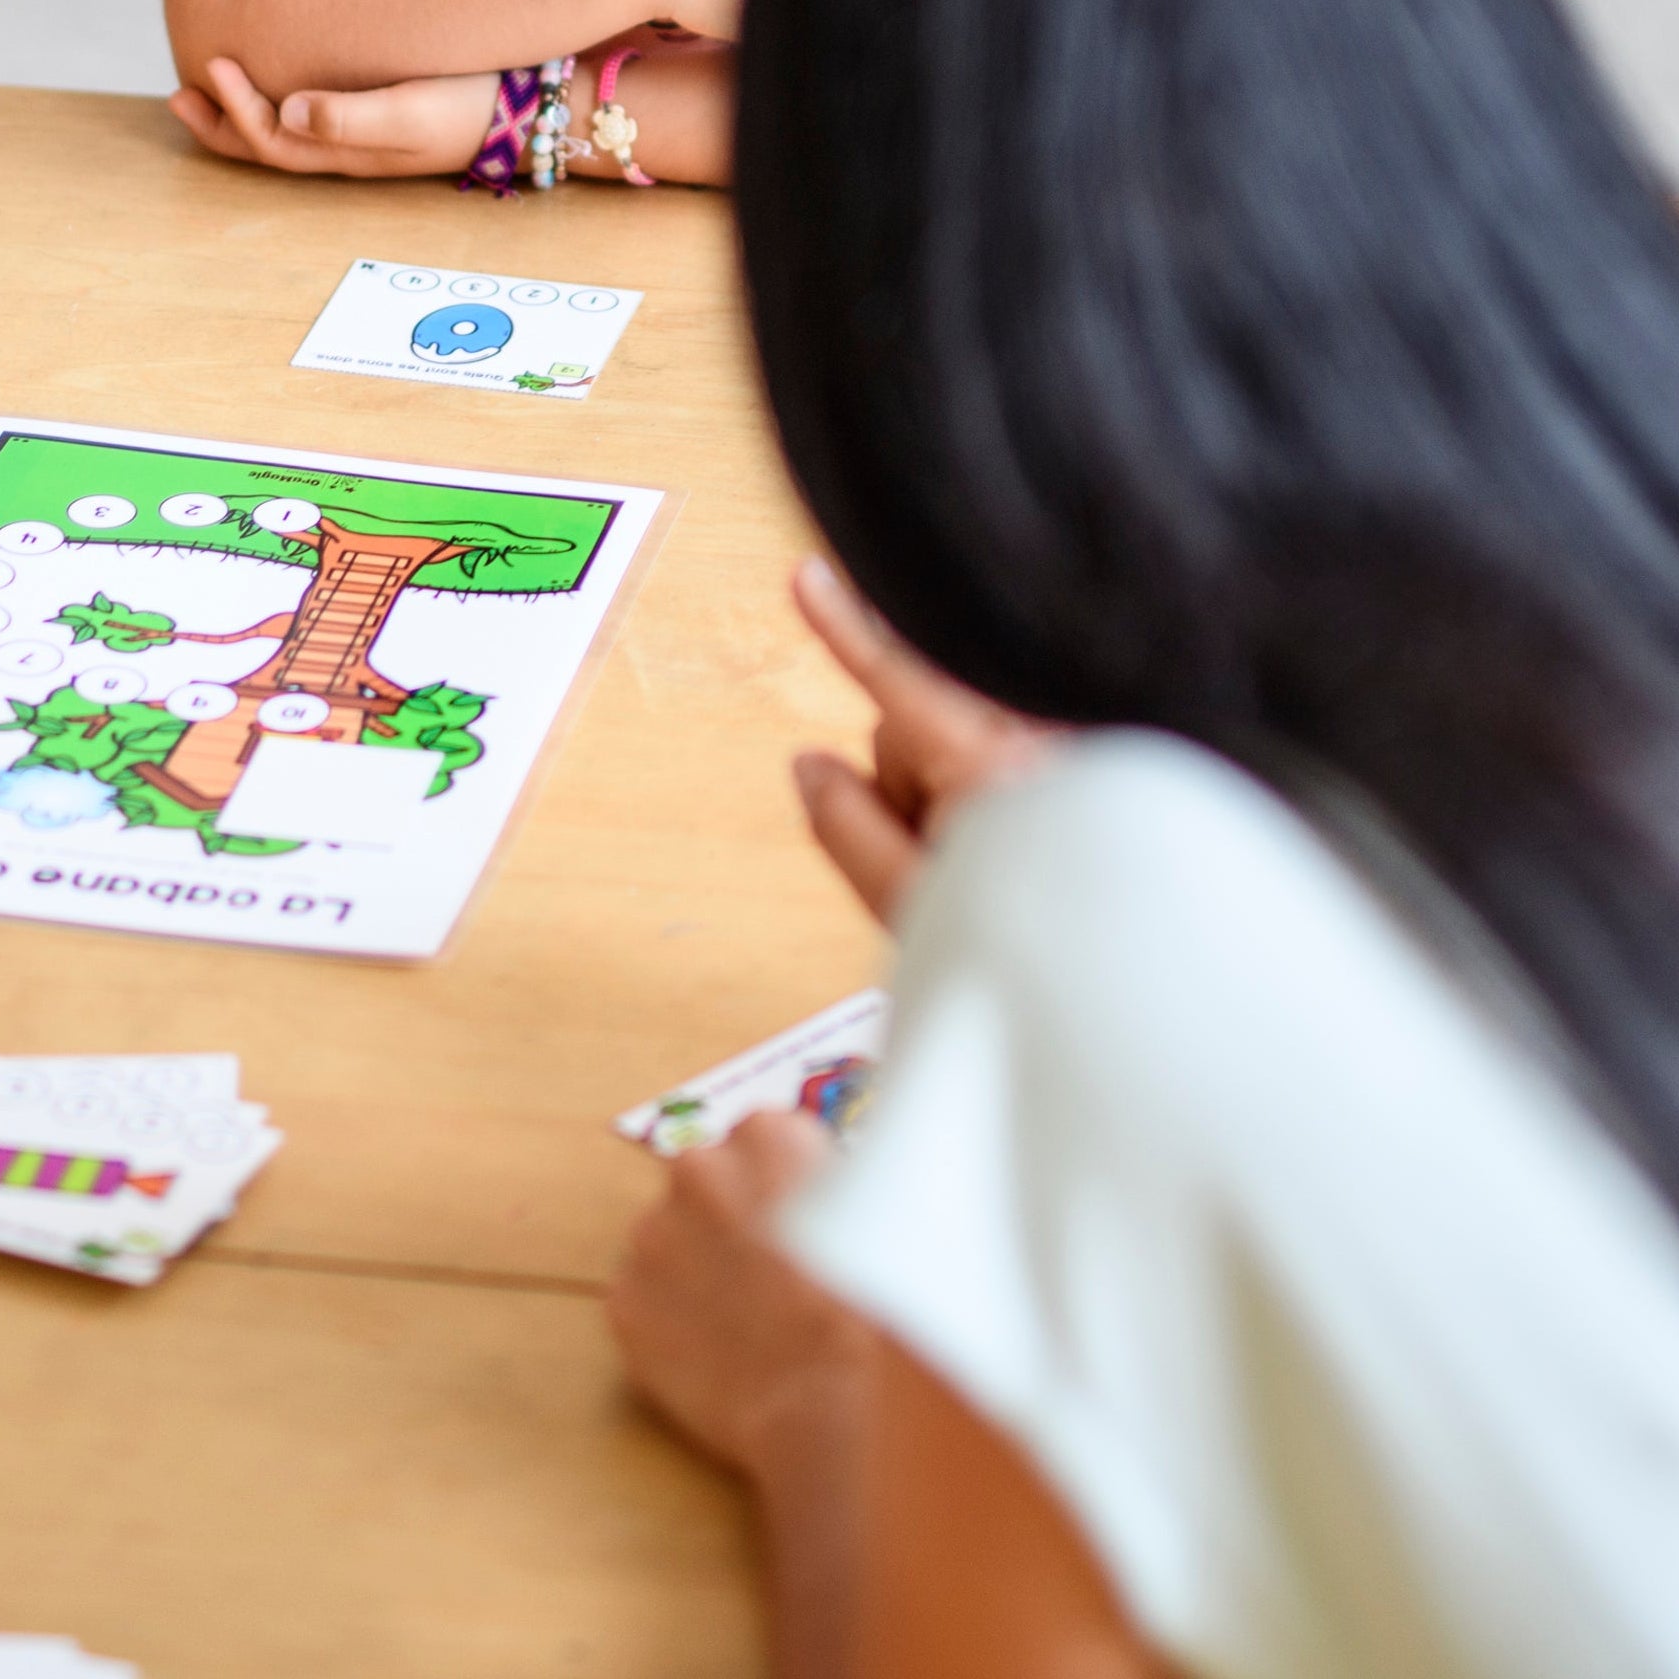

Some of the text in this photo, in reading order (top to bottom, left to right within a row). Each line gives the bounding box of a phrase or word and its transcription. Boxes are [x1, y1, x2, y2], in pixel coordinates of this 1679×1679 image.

[527, 289, 541, 298] 2
[94, 504, 291, 521] 1 2 3
[21, 532, 37, 544] 4
[18, 653, 33, 664] 7
[191, 696, 208, 707] 9
[281, 708, 307, 719] 10
[31, 870, 259, 906] cabane
[280, 895, 352, 922] La
